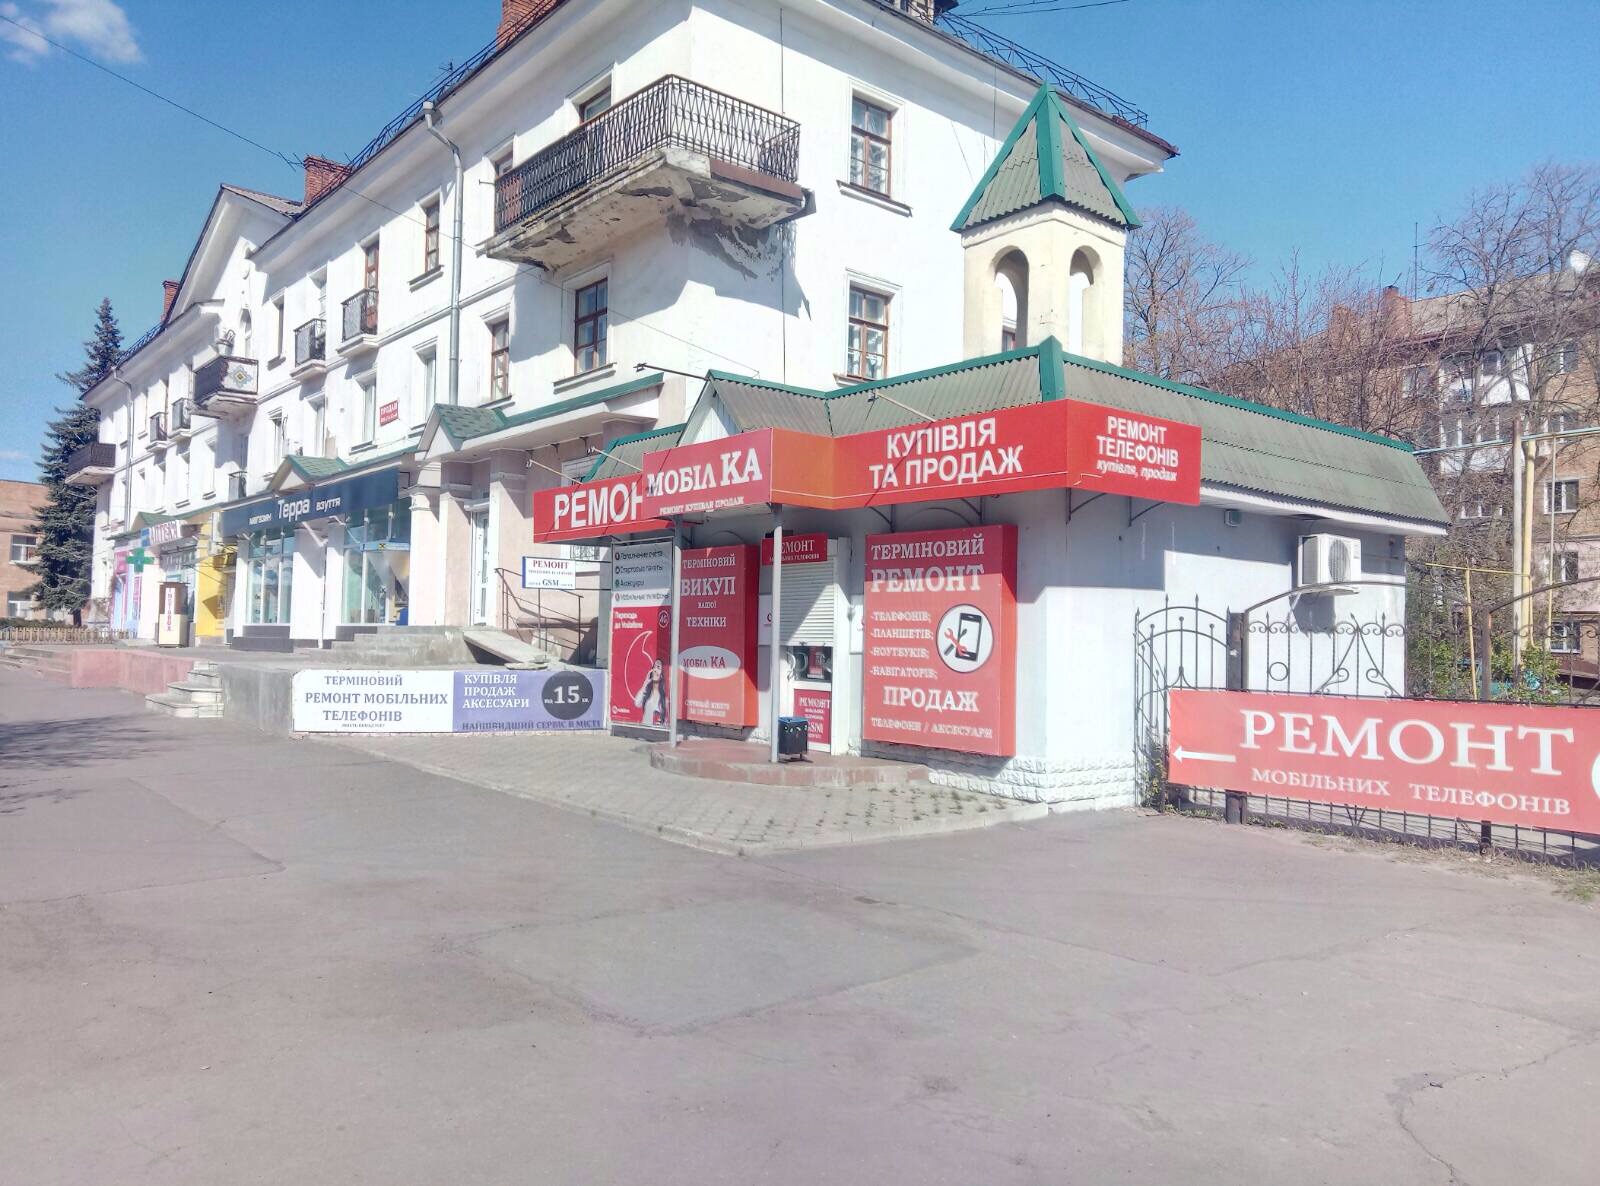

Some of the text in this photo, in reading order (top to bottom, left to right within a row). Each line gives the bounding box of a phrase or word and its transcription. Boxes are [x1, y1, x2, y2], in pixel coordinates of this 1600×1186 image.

[887, 417, 996, 459] КУПІВЛЯ
[1107, 415, 1167, 444] РЕМОНТ
[1096, 435, 1179, 467] ТЕЛЕФОНІВ
[868, 444, 1024, 489] ТА ПРОДАЖ
[1141, 466, 1177, 481] продаж
[278, 498, 310, 522] Терра
[554, 482, 643, 530] РЕМОН
[659, 504, 684, 515] РЕМОНТ
[714, 496, 744, 509] ПРОДАЖ
[870, 533, 985, 560] ТЕРМІНОВИЙ
[533, 560, 569, 569] РЕМОНТ
[682, 553, 736, 569] ТЕРМІНОВИЙ
[542, 578, 559, 587] GSM
[680, 576, 736, 596] ВИКУП
[870, 563, 985, 593] РЕМОНТ
[686, 616, 727, 628] ТЕХНІКИ
[324, 674, 403, 686] ТЕРМІНОВИЙ
[464, 674, 518, 684] КУПІВЛЯ
[305, 692, 448, 704] РЕМОНТ МОБІЛЬНИХ
[463, 686, 516, 698] ПРОДАЖ
[554, 685, 580, 704] 15
[882, 686, 980, 712] ПРОДАЖ
[462, 698, 530, 709] АКСЕСУАРИ
[323, 709, 403, 721] ТЕЛЕФОНІВ
[1239, 709, 1575, 776] РЕМОНТ
[1251, 767, 1571, 815] МОБІЛЬНИХ ТЕЛЕФОНІВ
